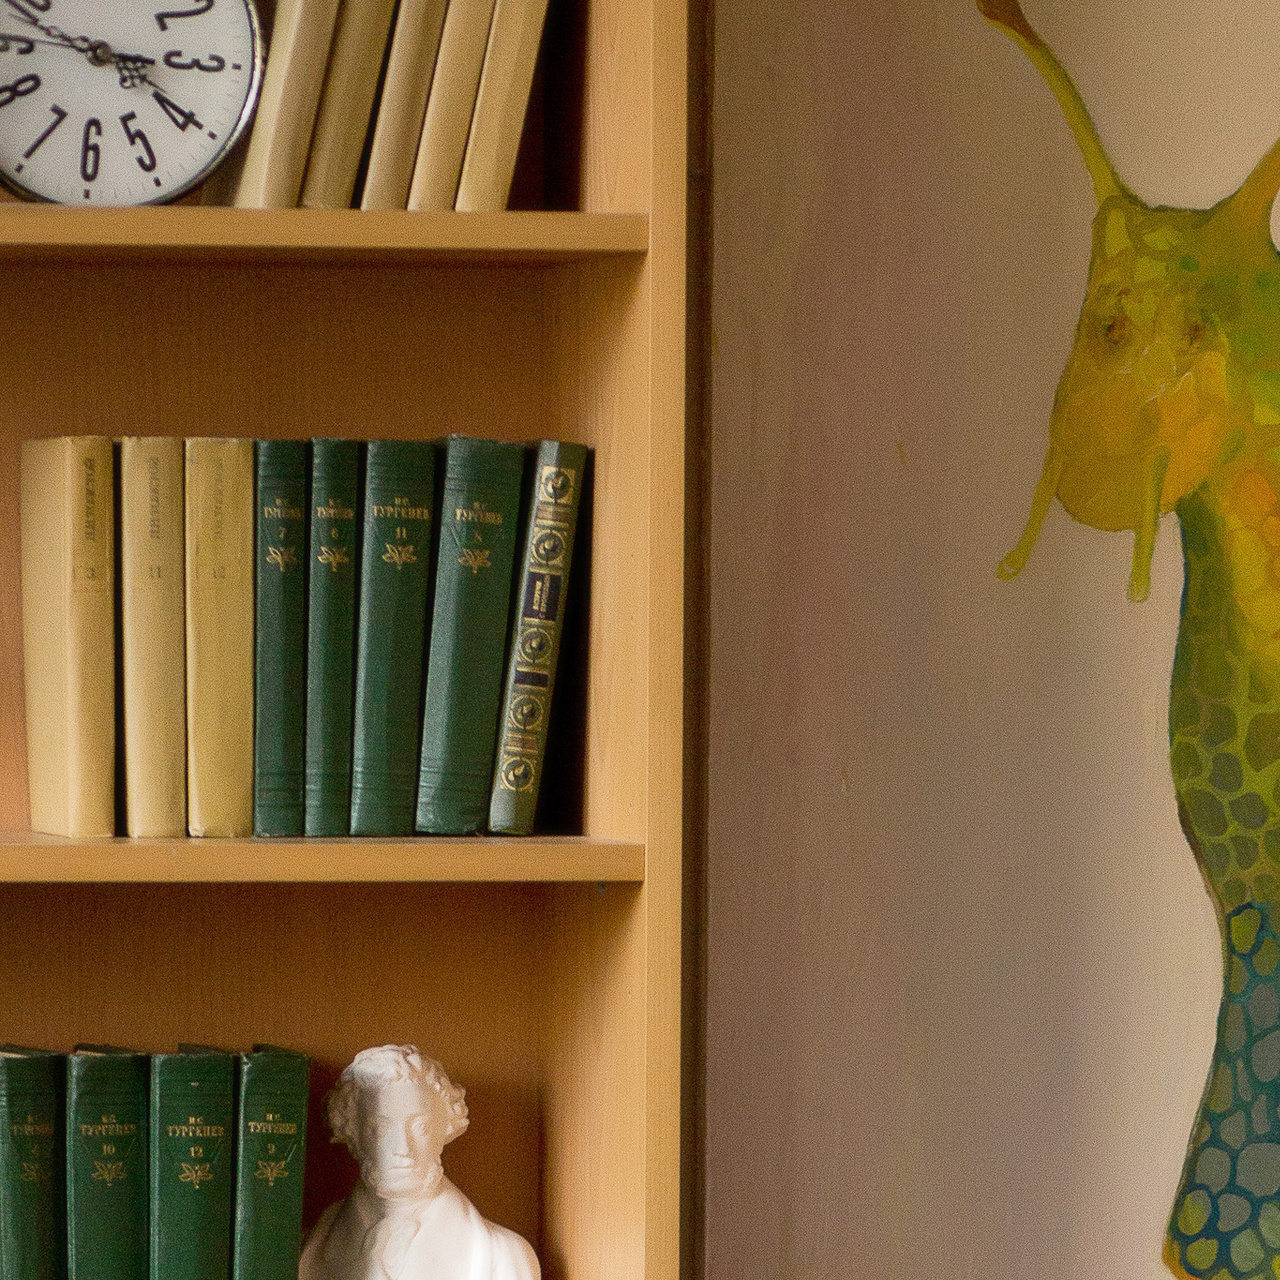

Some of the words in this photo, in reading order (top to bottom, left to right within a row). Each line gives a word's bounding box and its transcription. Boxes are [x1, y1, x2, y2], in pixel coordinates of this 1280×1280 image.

[163, 50, 226, 72] 3
[23, 104, 69, 159] 7
[152, 90, 203, 132] 4
[80, 117, 102, 182] 6
[119, 111, 157, 172] 5
[166, 1125, 225, 1137] ТУРГЕНЕВ
